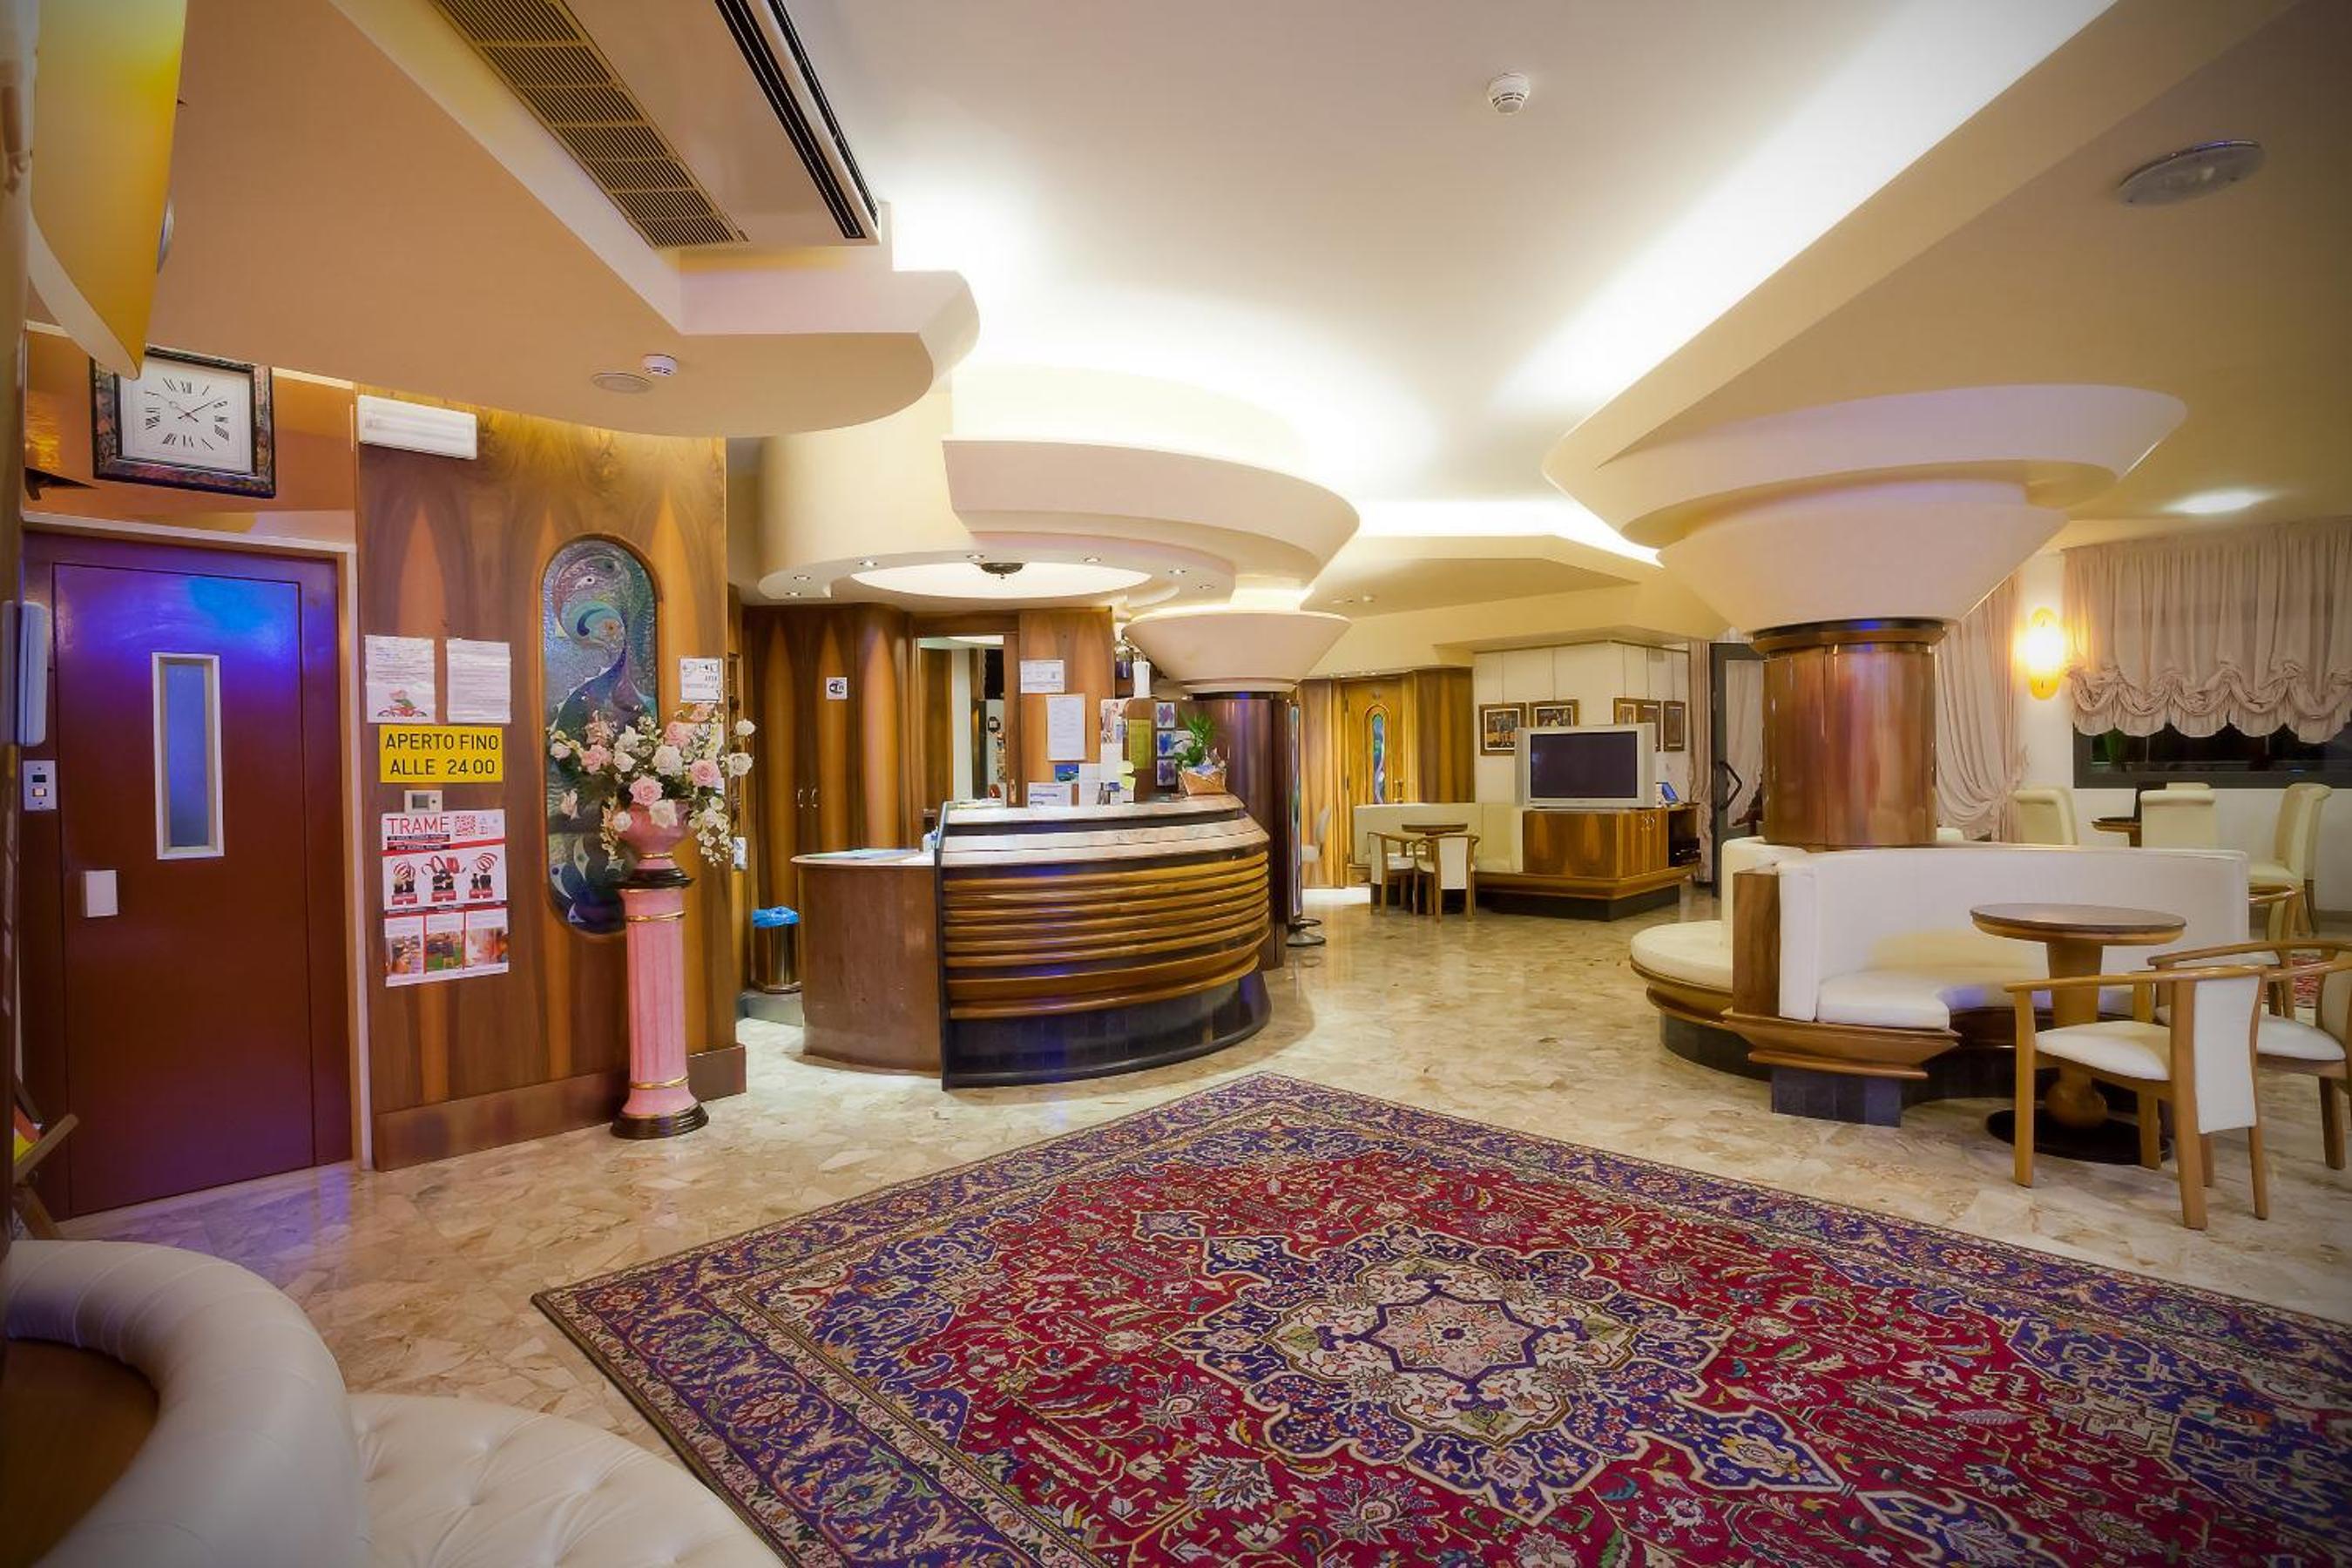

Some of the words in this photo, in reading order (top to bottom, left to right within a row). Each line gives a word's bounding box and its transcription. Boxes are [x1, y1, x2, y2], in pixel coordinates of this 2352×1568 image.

[385, 733, 454, 750] APERTO
[460, 735, 499, 751] FINO
[390, 759, 436, 775] ALLE
[386, 816, 449, 835] TRAME
